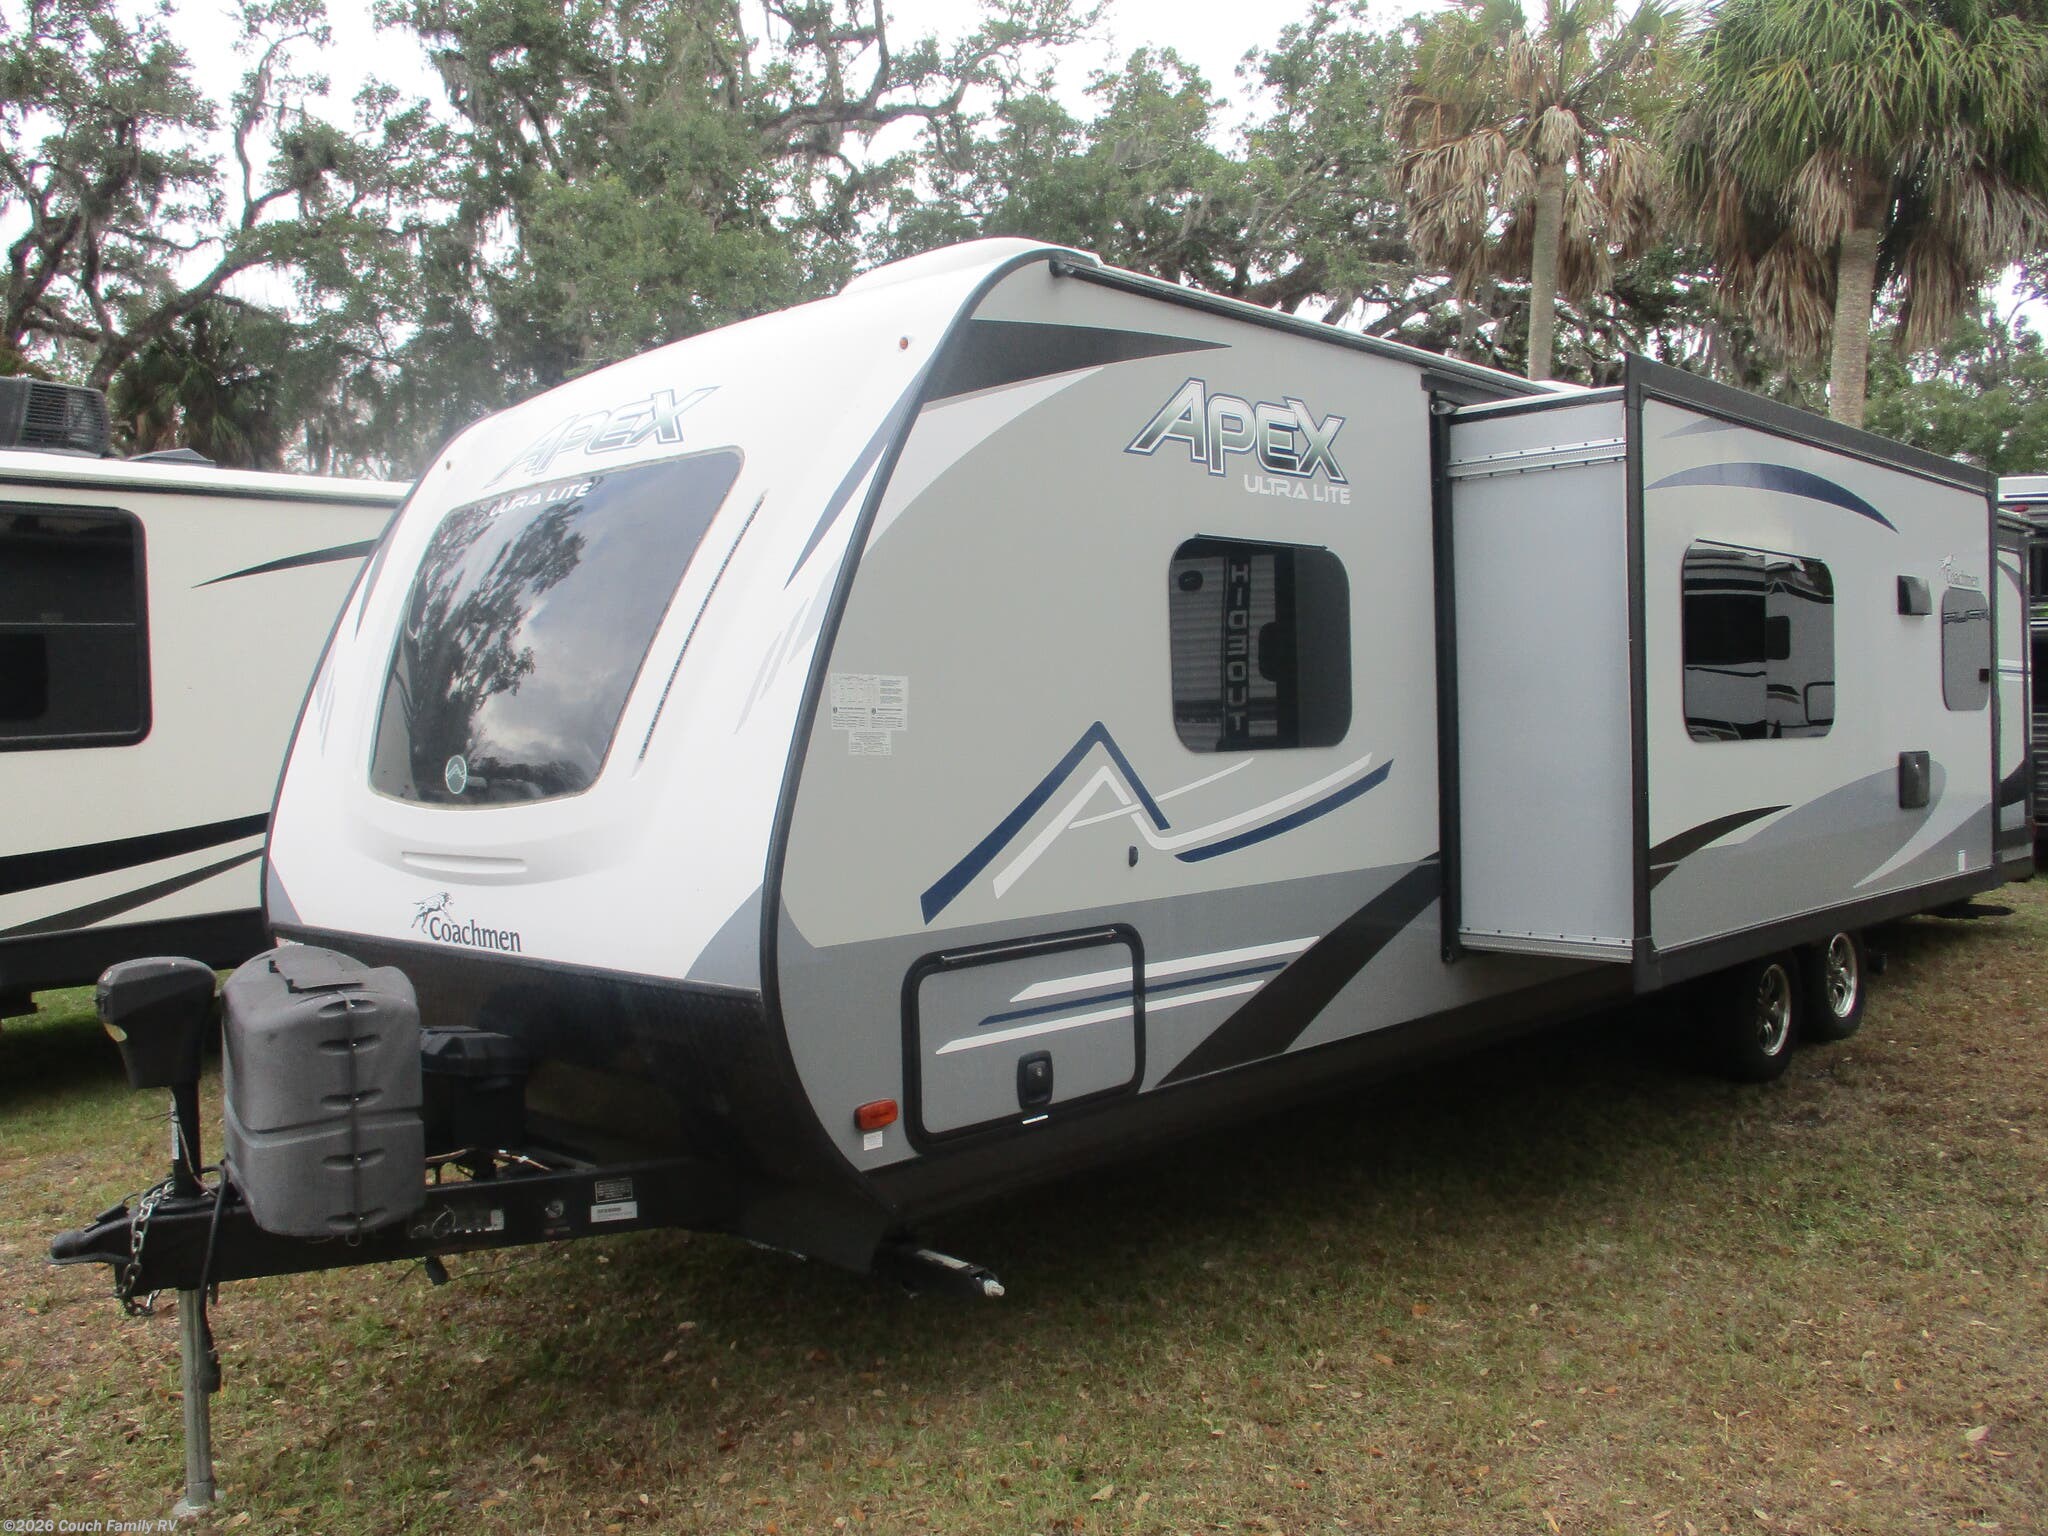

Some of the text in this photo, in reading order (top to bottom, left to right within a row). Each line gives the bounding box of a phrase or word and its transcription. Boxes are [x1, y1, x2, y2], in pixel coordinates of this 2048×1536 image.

[483, 385, 722, 489] APEX
[1123, 377, 1348, 484] APEX
[489, 481, 593, 517] ULTRA LITE
[1243, 473, 1351, 505] ULTRA LITE
[429, 916, 522, 953] Coachmen
